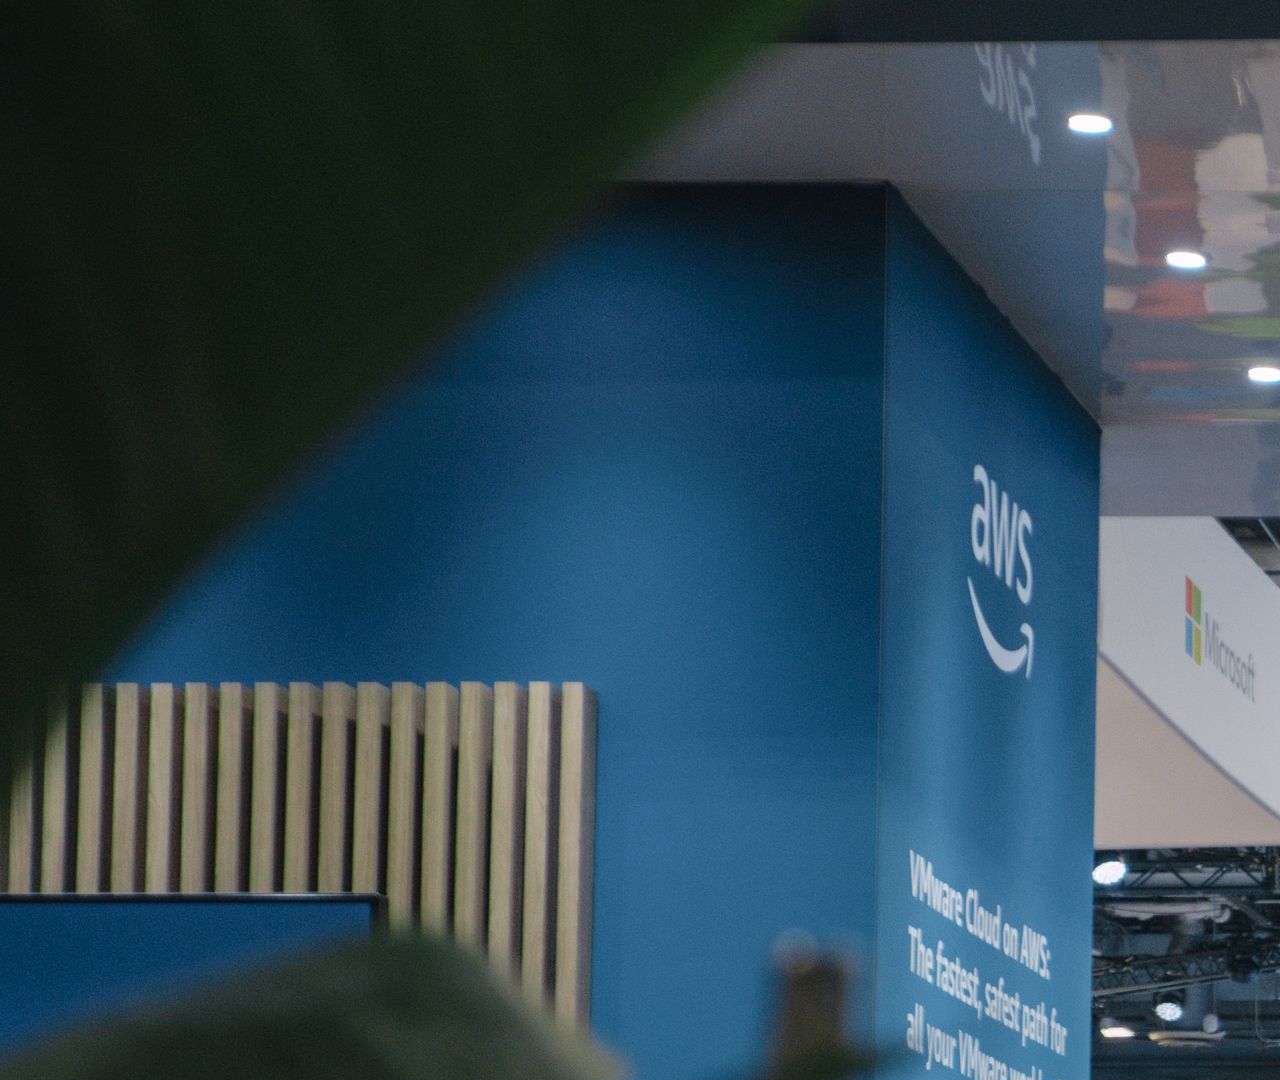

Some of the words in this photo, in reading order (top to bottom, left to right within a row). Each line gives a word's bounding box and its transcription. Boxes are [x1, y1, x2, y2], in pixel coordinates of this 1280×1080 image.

[970, 464, 1034, 606] aws
[1204, 611, 1256, 704] Microsoft
[908, 849, 963, 927] VMware
[965, 888, 1001, 950] Cloud
[1002, 921, 1018, 960] on
[1020, 924, 1051, 980] AWS:
[906, 1003, 924, 1054] all
[925, 1023, 956, 1071] your
[907, 925, 933, 983] The
[936, 940, 982, 1020] fastest,
[984, 977, 1021, 1033] safest
[1021, 1002, 1048, 1047] path
[1049, 1008, 1067, 1056] for
